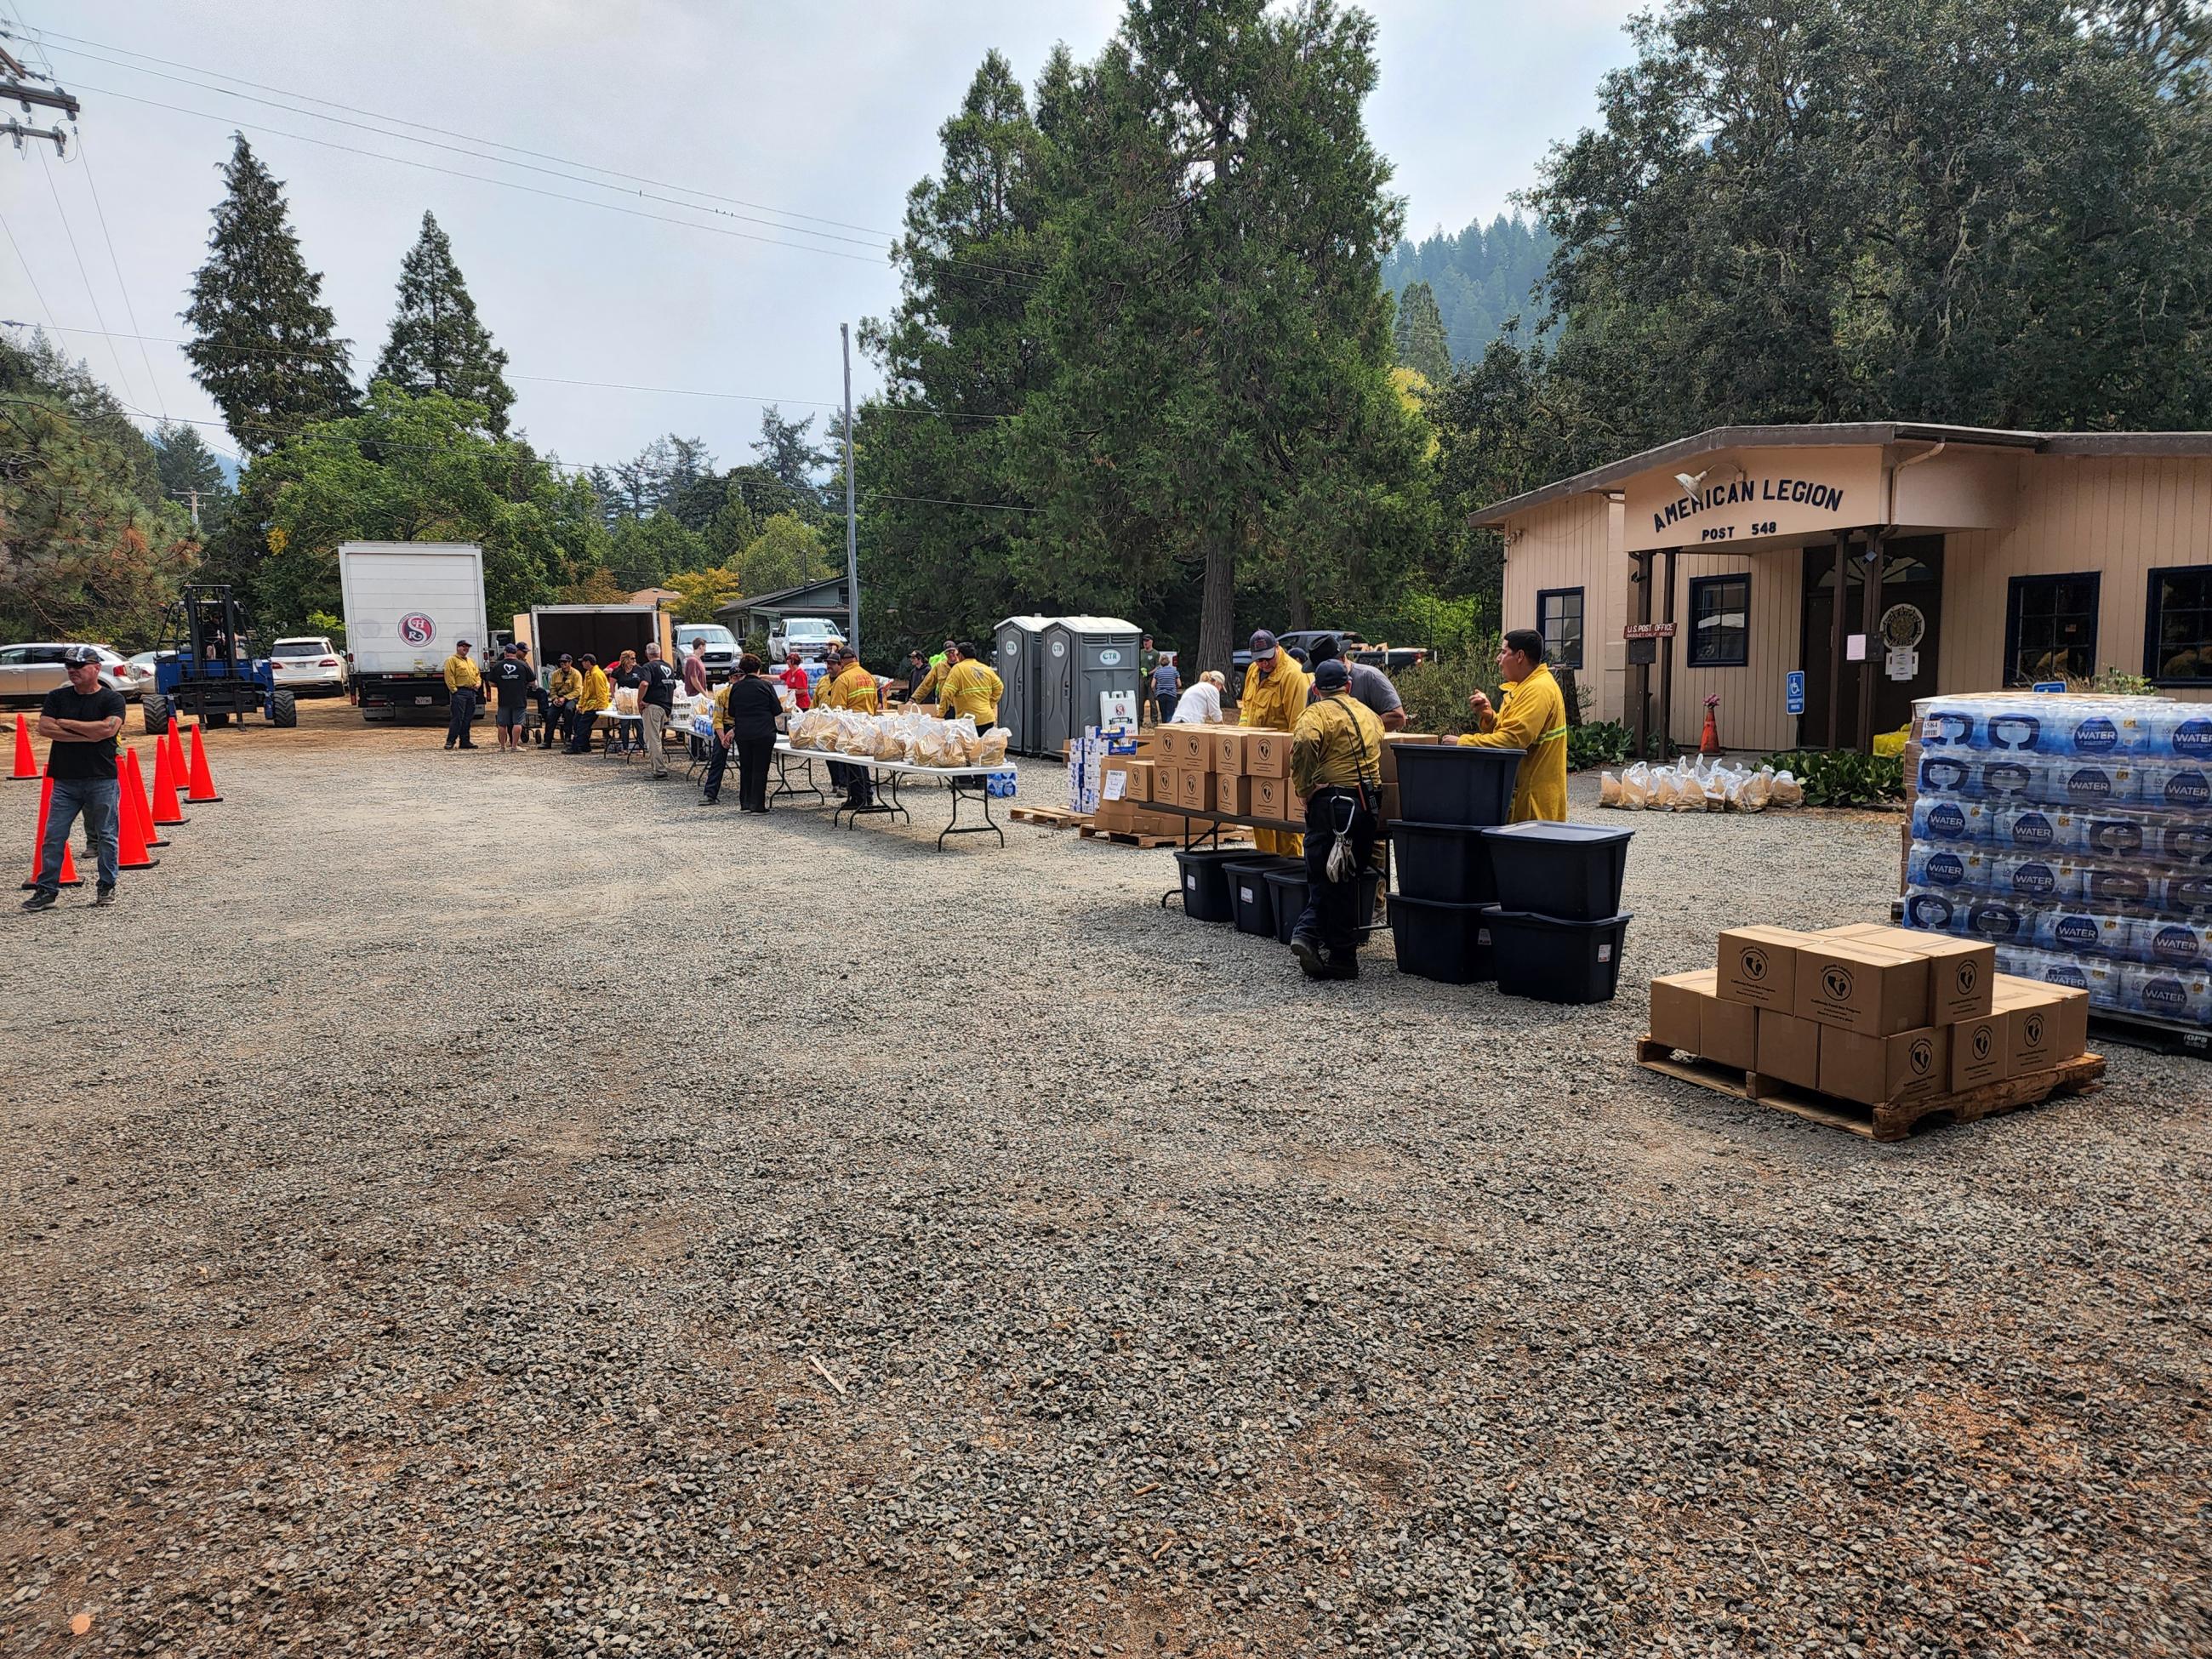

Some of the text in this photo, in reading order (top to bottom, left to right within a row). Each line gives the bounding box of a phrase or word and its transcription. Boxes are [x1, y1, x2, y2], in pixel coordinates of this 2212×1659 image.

[1763, 479, 1844, 512] LEGION
[1702, 522, 1777, 541] POST 548
[1654, 623, 1673, 632] OFFICE
[1053, 644, 1063, 653] CTR
[1103, 652, 1117, 660] CTR
[2077, 731, 2116, 740] WATER
[2070, 781, 2109, 791] WATER
[2168, 784, 2209, 797] WATER
[1930, 814, 1964, 827] WATER
[2015, 826, 2052, 837] WATER
[1929, 863, 1963, 875] WATER
[2015, 875, 2053, 886] WATER
[2058, 926, 2096, 938] WATER
[2156, 938, 2198, 951] WATER
[2145, 989, 2186, 1003] WATER
